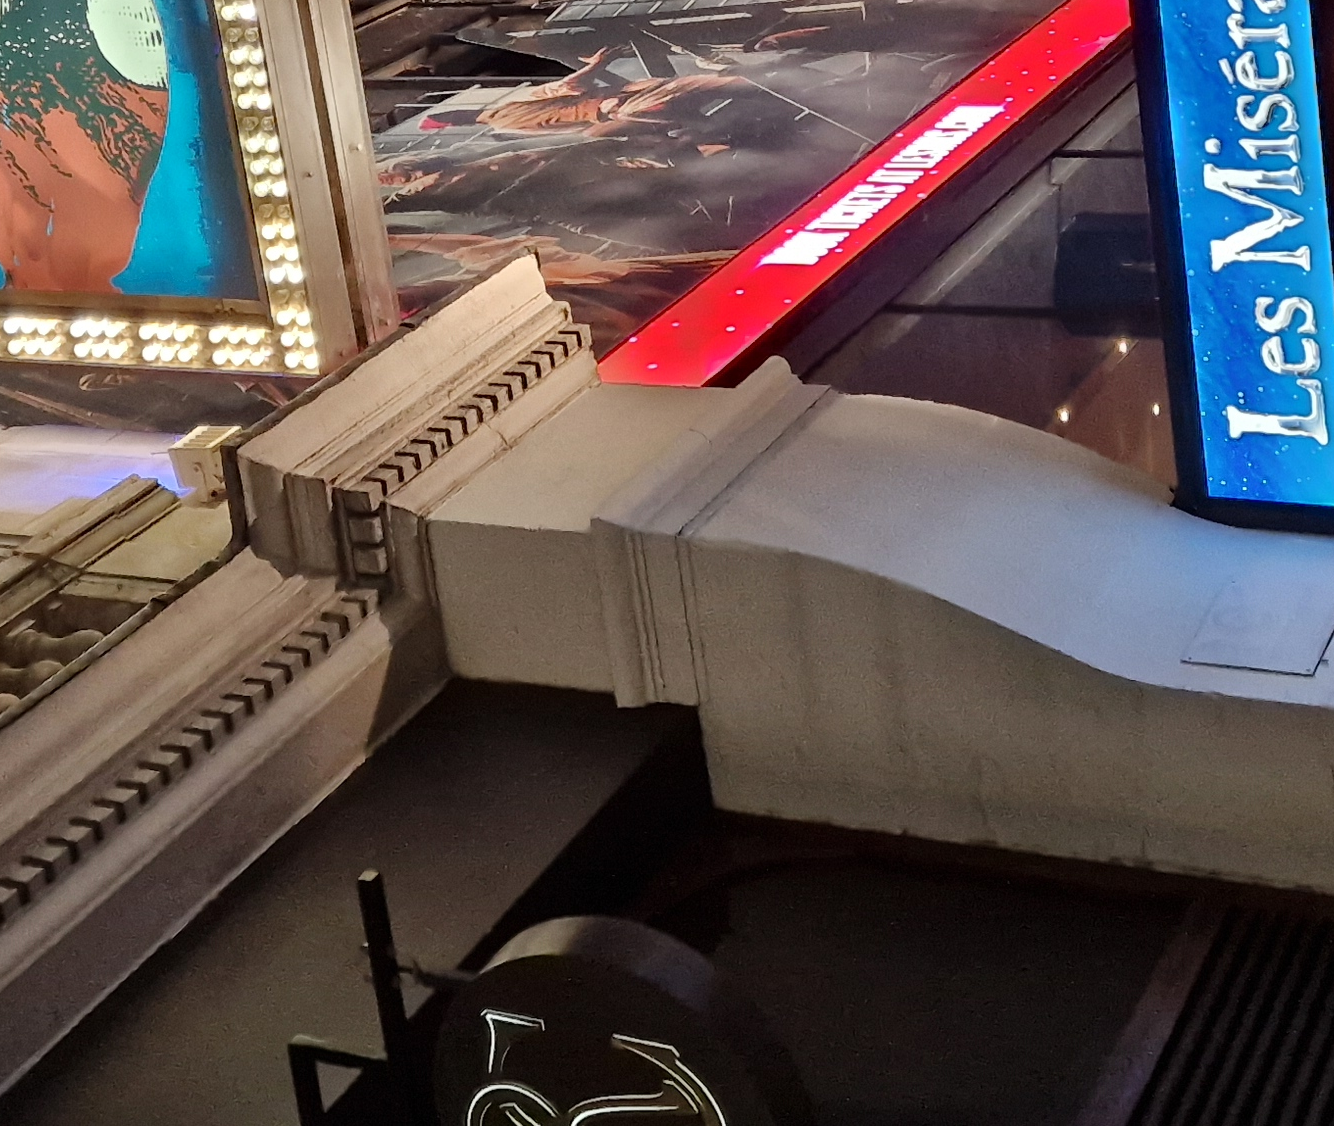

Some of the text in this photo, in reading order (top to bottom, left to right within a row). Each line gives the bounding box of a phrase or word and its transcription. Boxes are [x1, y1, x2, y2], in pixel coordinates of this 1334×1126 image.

[804, 184, 906, 231] TICKETS
[865, 169, 925, 184] AT
[1224, 296, 1329, 446] Les
